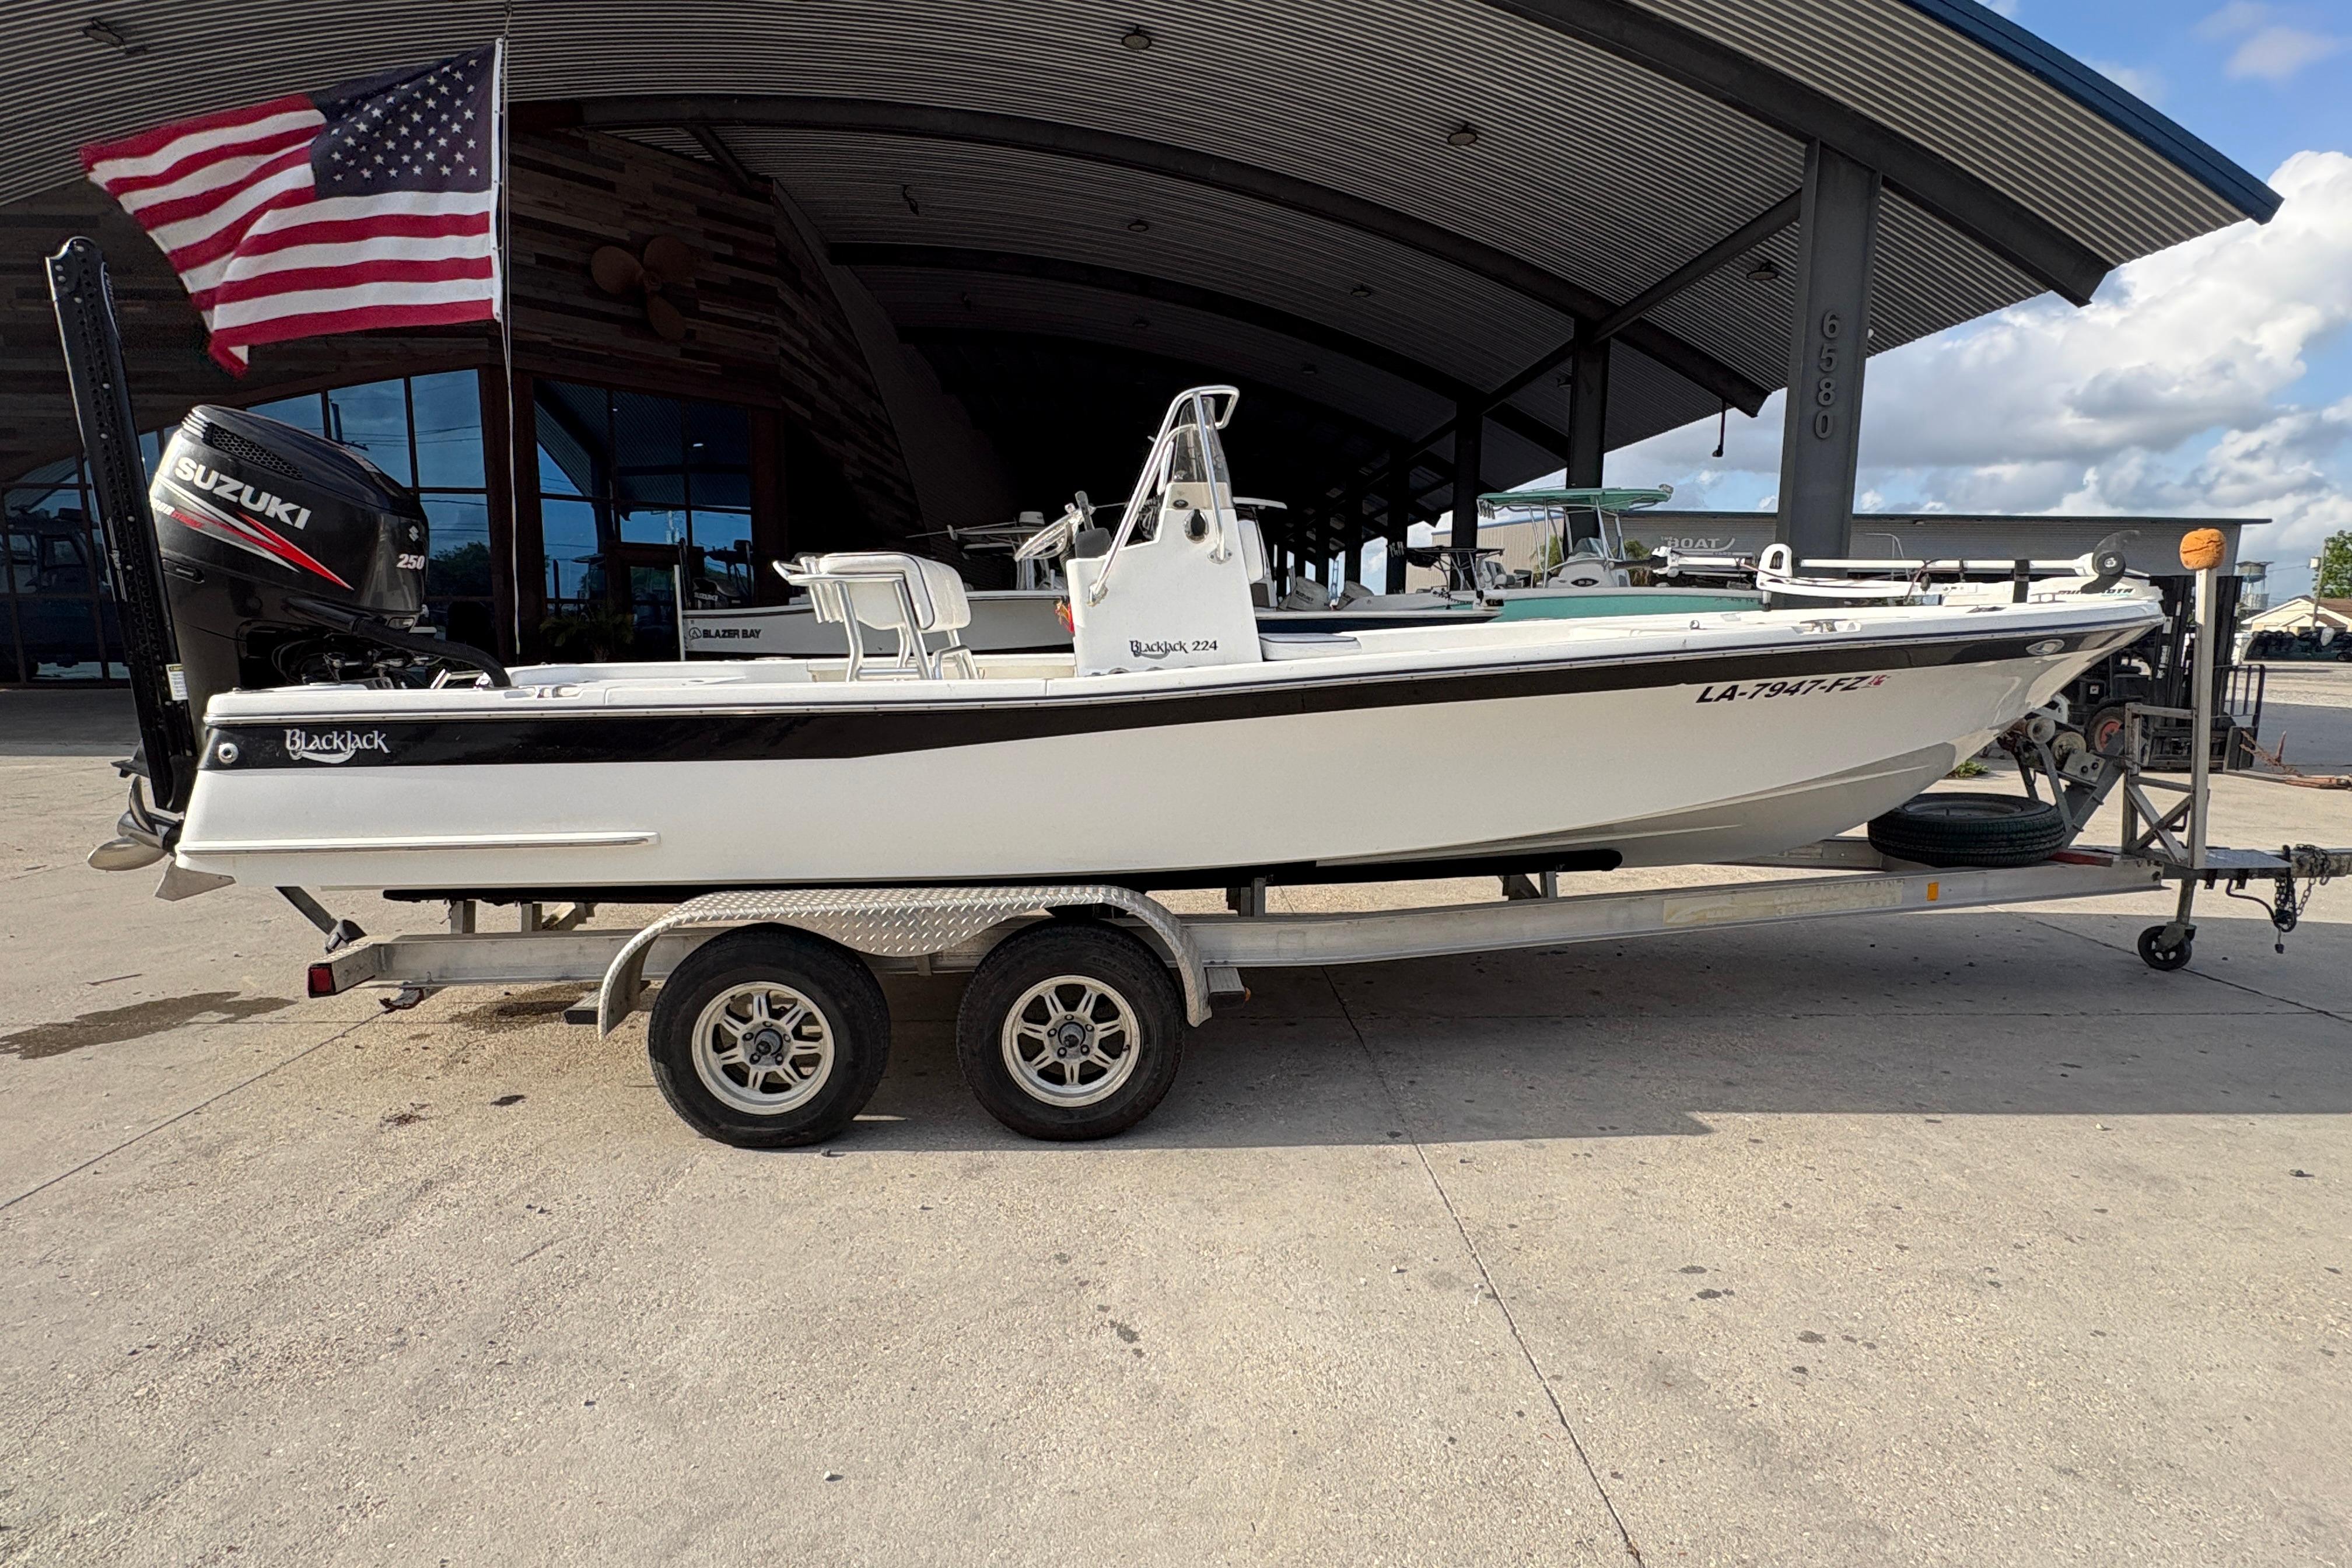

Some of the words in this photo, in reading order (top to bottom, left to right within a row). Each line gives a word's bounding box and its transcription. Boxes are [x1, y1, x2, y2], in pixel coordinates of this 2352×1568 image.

[1815, 309, 1839, 439] 6580
[175, 457, 312, 530] SUZUKI
[1668, 537, 1720, 548] BOAT
[397, 554, 425, 570] 250
[702, 629, 740, 639] BLAZER
[741, 629, 762, 639] BAY
[1192, 640, 1218, 651] 224
[1696, 676, 1871, 704] LA-7947-FZ
